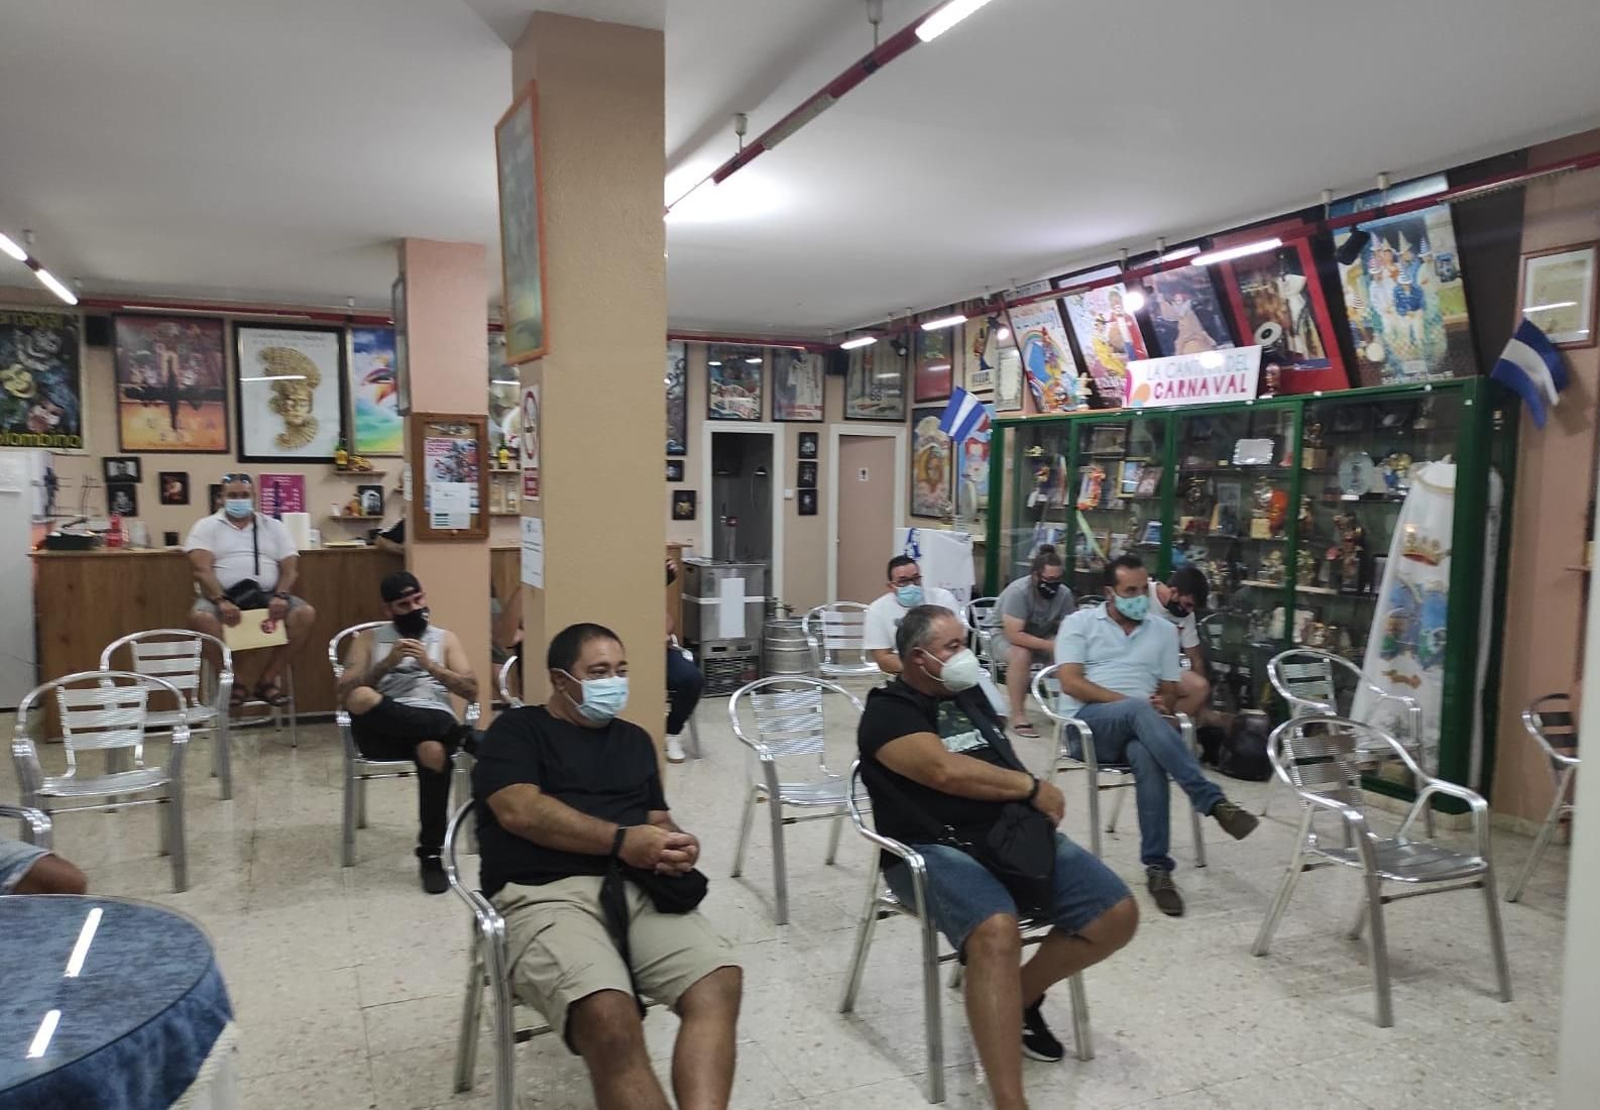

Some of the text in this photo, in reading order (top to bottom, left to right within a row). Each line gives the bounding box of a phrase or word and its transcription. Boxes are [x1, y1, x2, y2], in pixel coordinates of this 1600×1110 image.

[1146, 353, 1249, 381] LA CANT DEL
[1153, 373, 1247, 400] CARNAVAL
